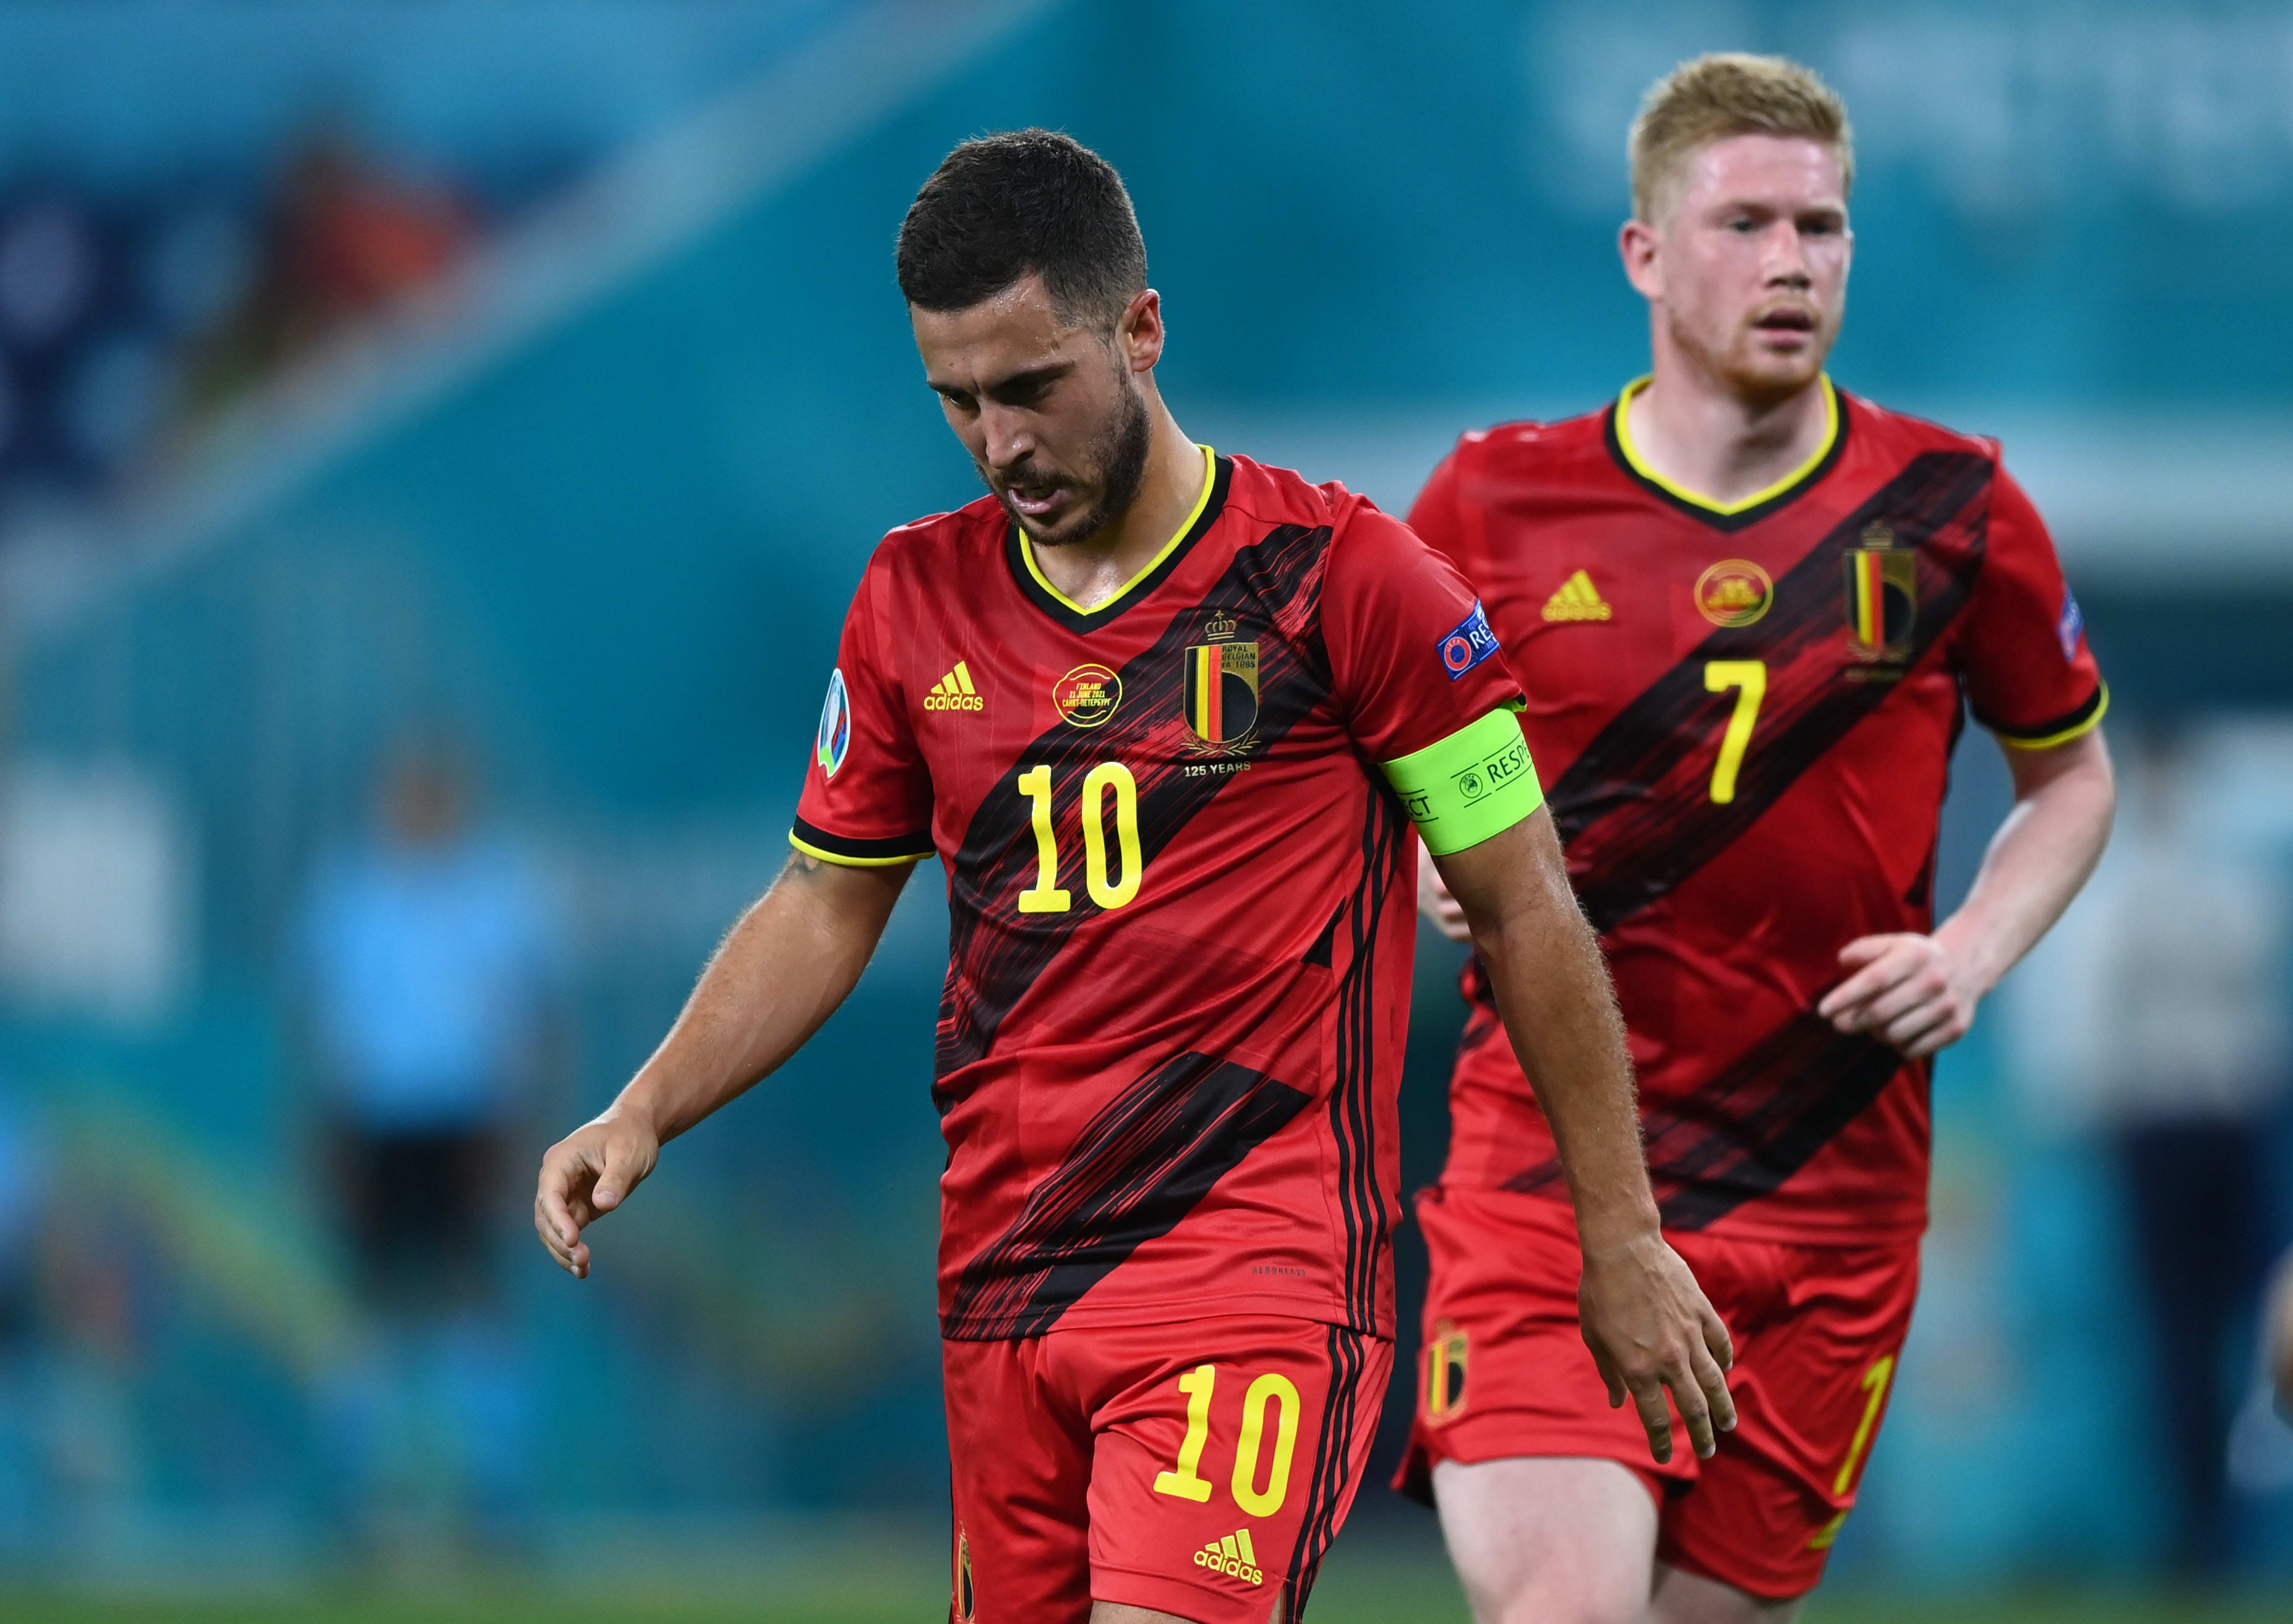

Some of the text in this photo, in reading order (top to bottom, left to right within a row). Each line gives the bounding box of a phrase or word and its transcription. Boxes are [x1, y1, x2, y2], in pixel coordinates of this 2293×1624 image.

[1222, 652, 1256, 660] BELGIAN
[1069, 690, 1105, 699] 21 JUNE 2021
[1076, 683, 1102, 691] FINLAND
[924, 692, 984, 711] adidas
[1704, 660, 1766, 804] 7
[1185, 761, 1251, 777] 125 YEARS
[1018, 761, 1142, 913] 10
[1153, 1364, 1300, 1517] 10
[1194, 1550, 1262, 1585] adidas
